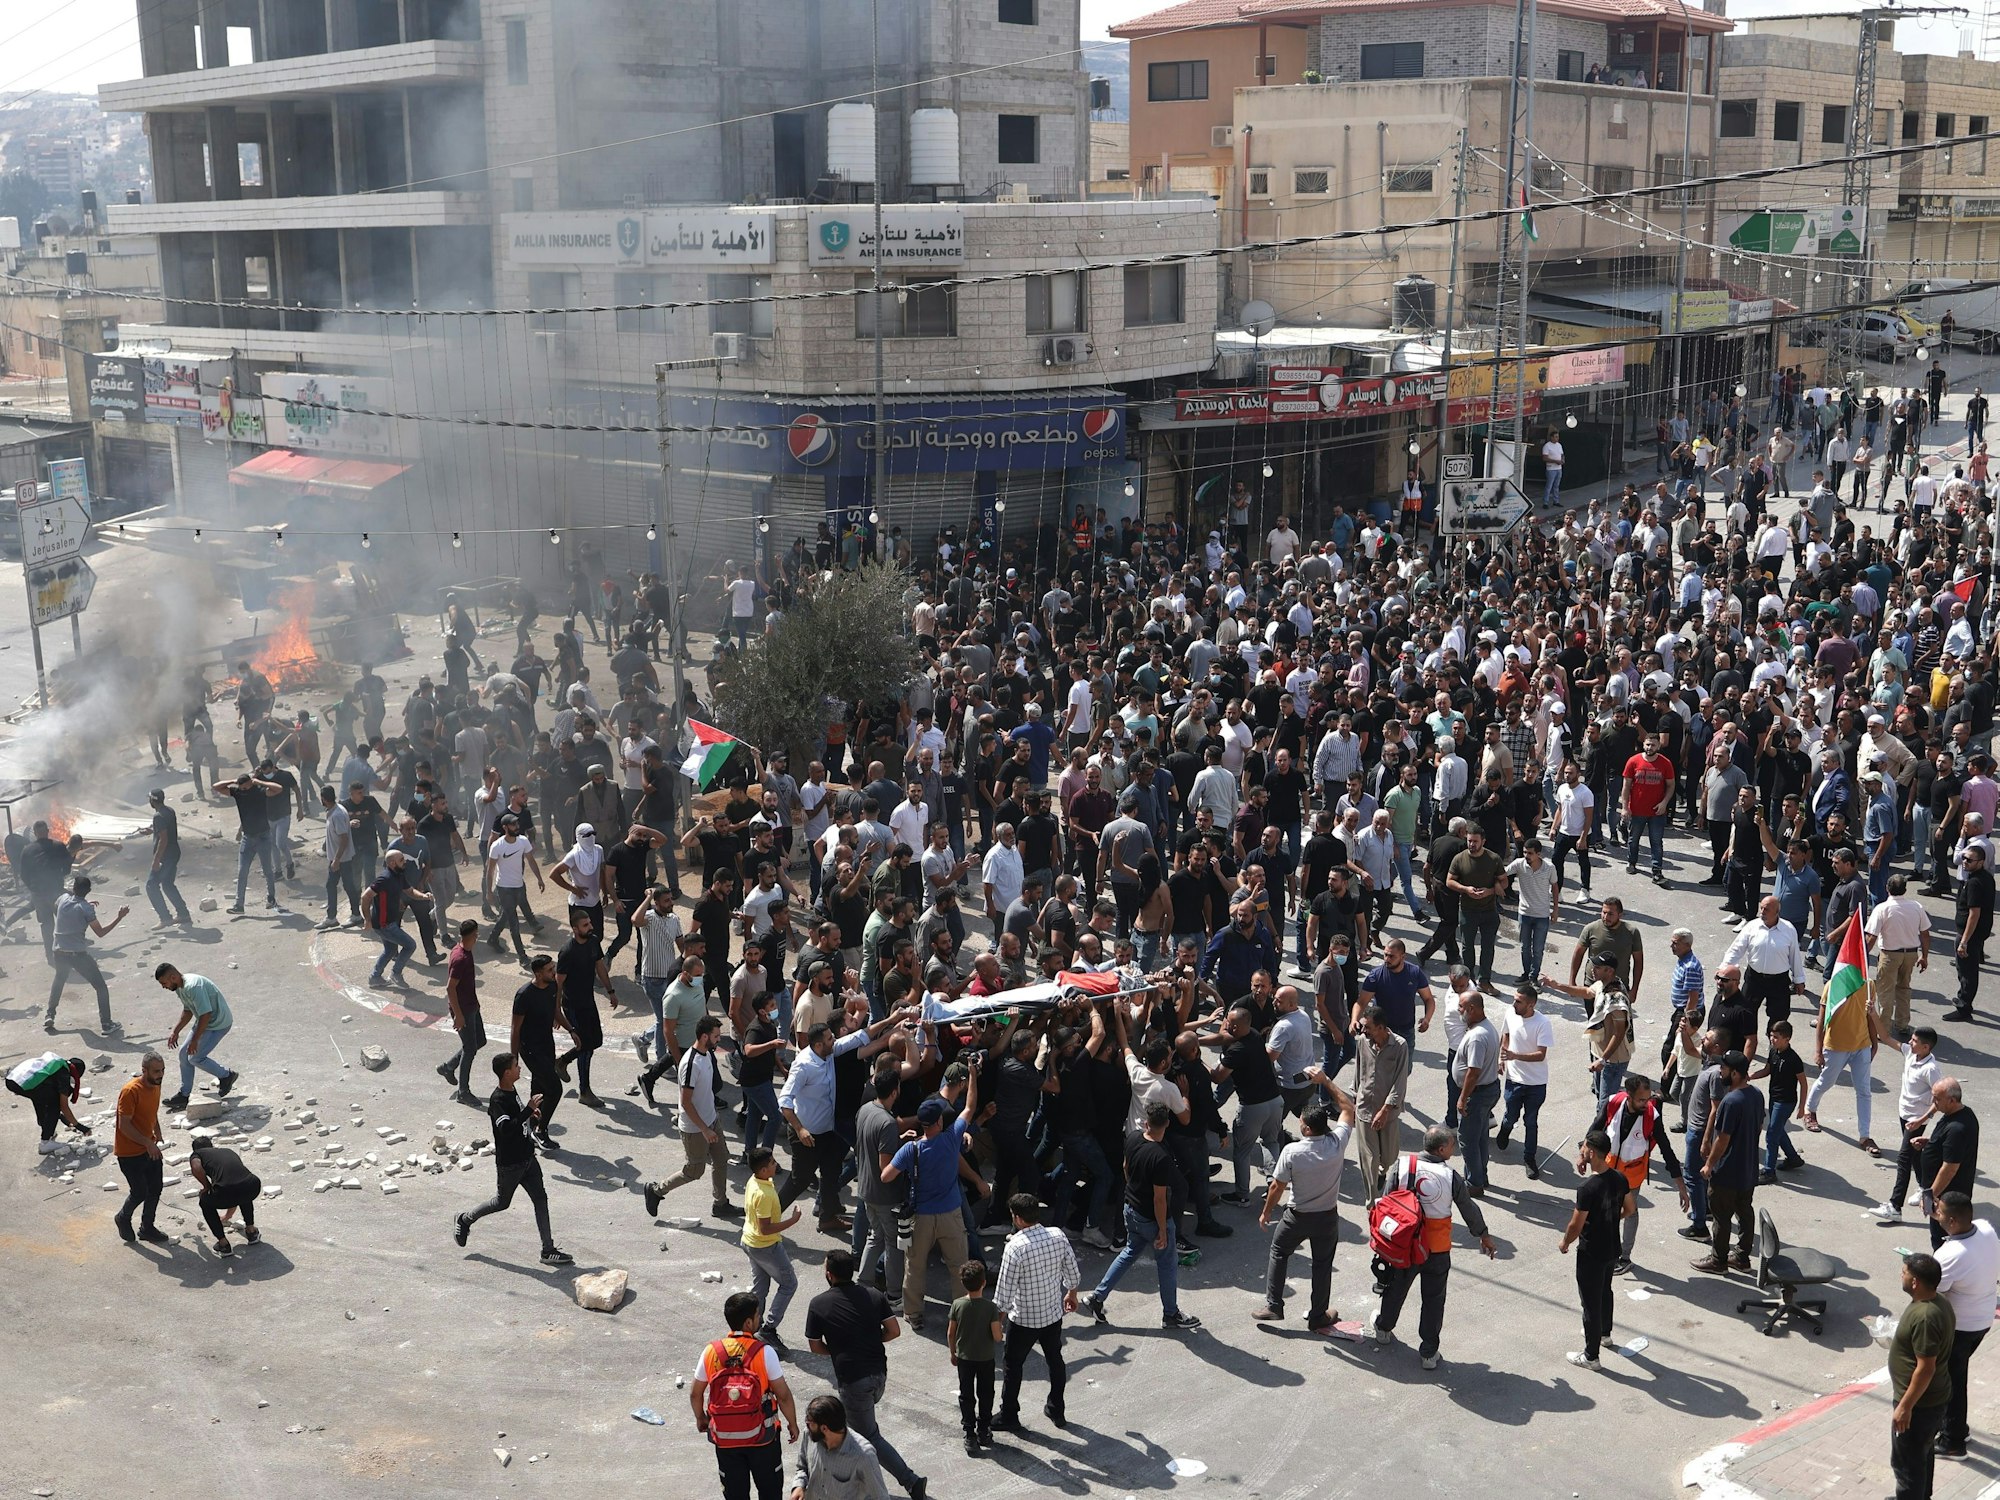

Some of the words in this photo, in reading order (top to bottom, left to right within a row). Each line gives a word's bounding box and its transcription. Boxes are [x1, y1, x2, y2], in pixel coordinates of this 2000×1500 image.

[514, 233, 546, 248] AHLIA
[549, 233, 612, 248] INSURANCE
[650, 222, 705, 256] للتأمين
[711, 221, 765, 257] الأهلية
[914, 223, 961, 244] الأهلية
[859, 248, 893, 257] AHIA
[896, 248, 962, 257] INSURANCE
[1571, 355, 1597, 368] Classic
[1277, 372, 1318, 380] 0598551443
[925, 424, 996, 450] ووجبة
[1001, 424, 1078, 448] مطعم
[1084, 446, 1119, 461] pepsi
[1447, 462, 1469, 473] 5076
[22, 487, 33, 499] 60
[32, 537, 76, 557] Jerusalem
[943, 785, 956, 794] ESEL
